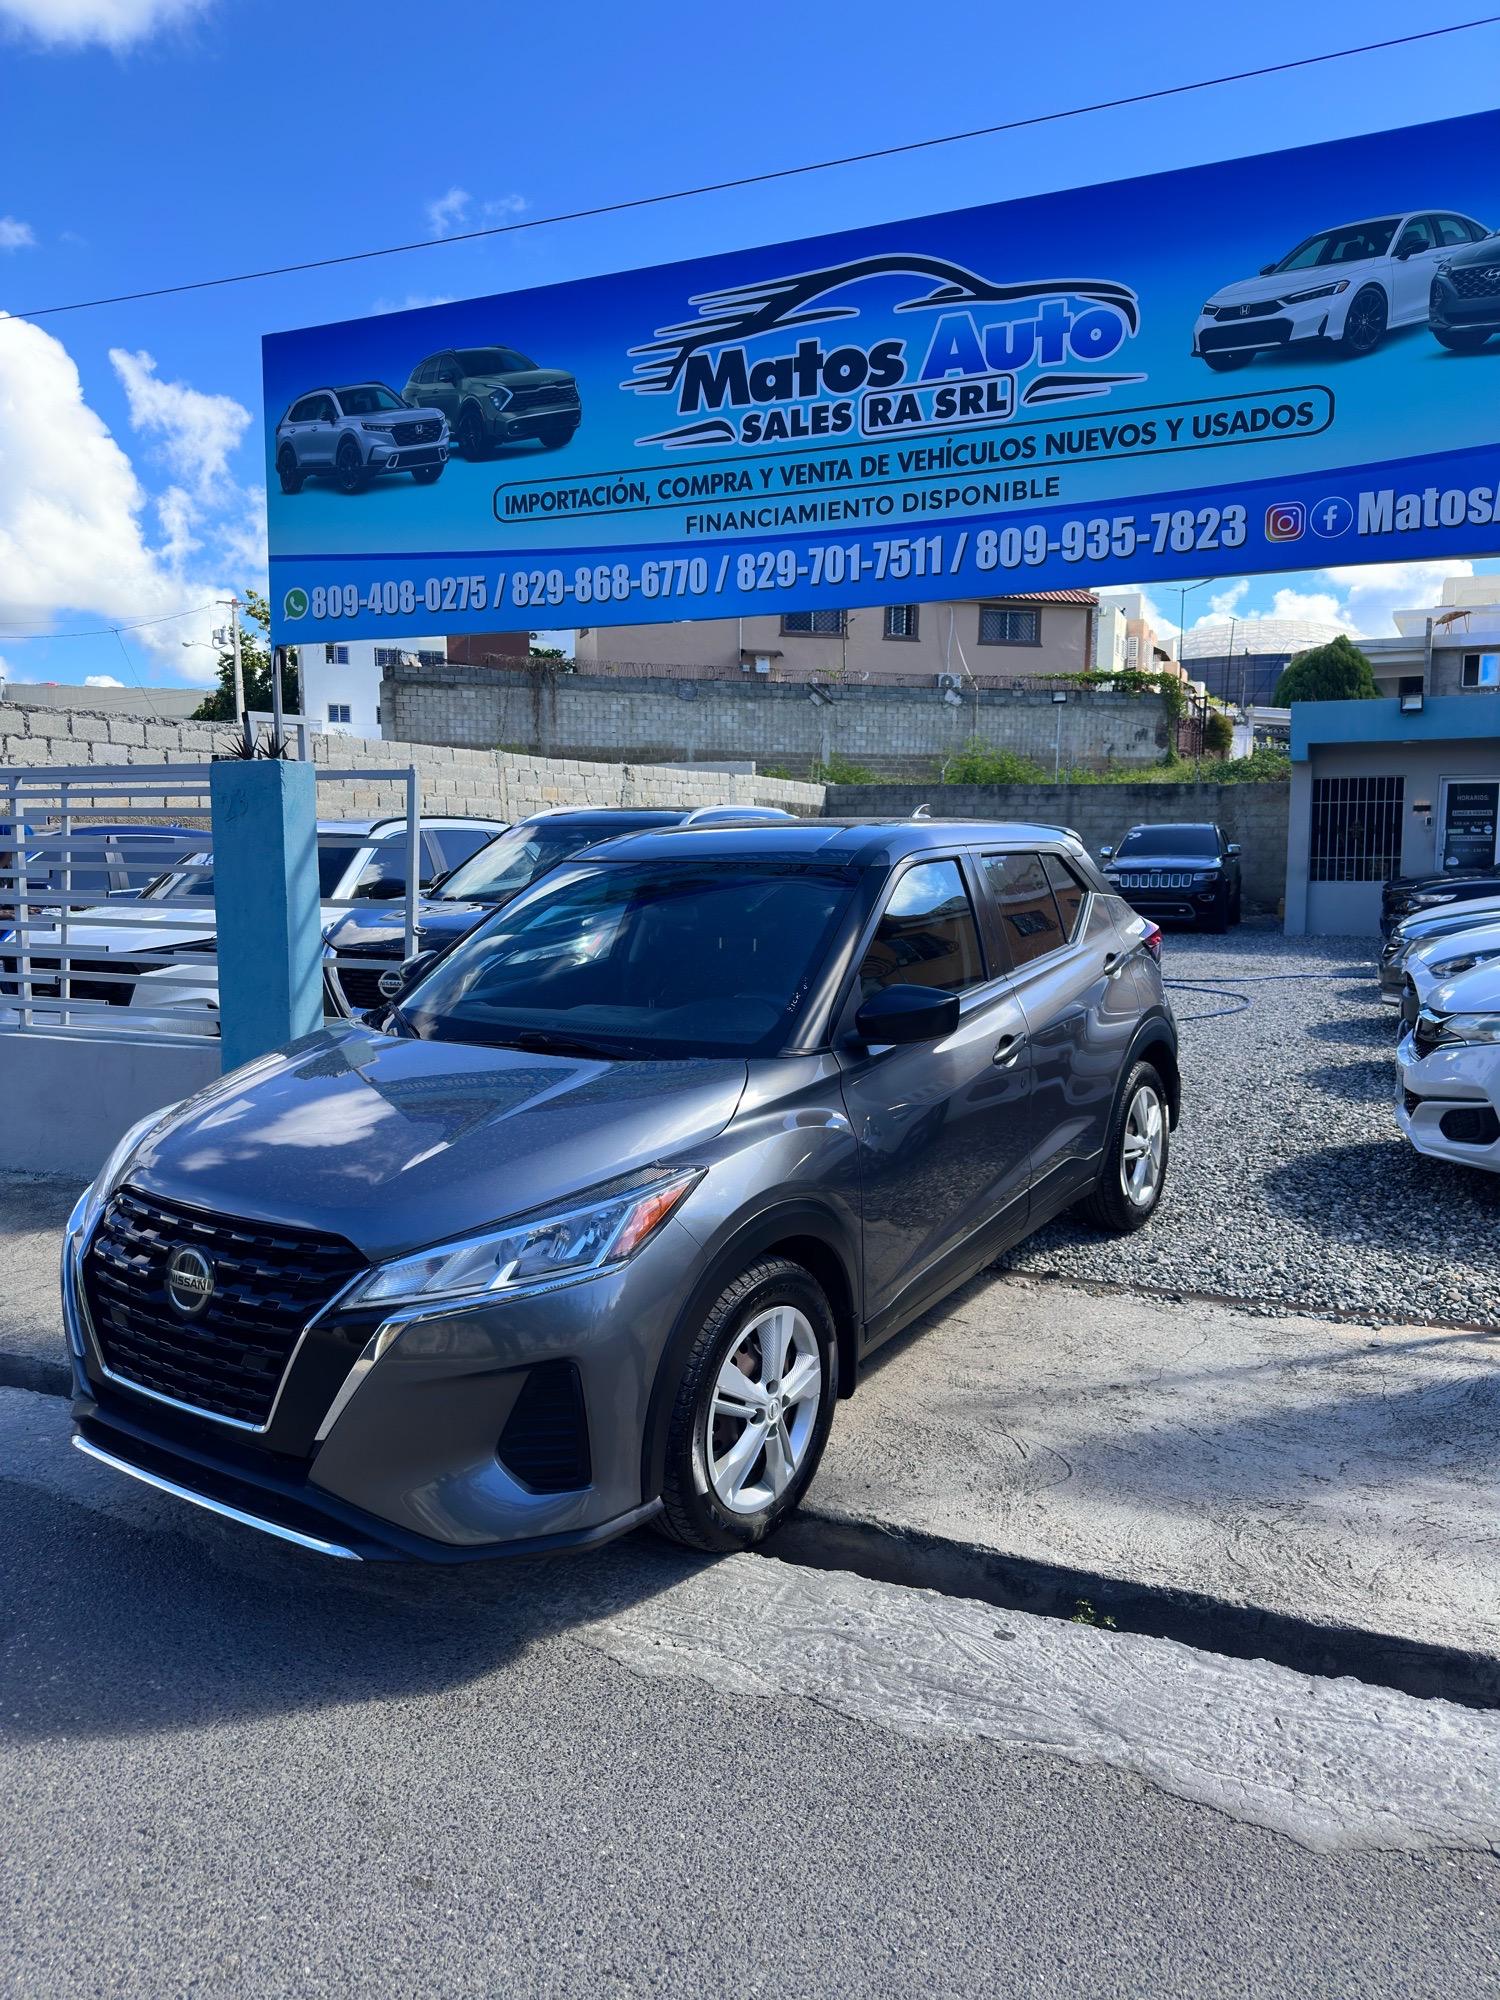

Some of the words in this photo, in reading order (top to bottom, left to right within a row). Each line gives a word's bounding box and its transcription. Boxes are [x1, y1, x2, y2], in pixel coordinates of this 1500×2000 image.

[678, 340, 905, 413] Matos
[921, 300, 1123, 380] Auto
[741, 402, 852, 444] SALES
[868, 393, 924, 428] RA
[934, 382, 1007, 419] SRL
[504, 477, 651, 515] IMPORTACIÓN,
[657, 471, 753, 500] COMPRA
[759, 468, 774, 488] Y
[780, 459, 853, 487] VENTA
[861, 454, 890, 478] DE
[898, 435, 1037, 473] VEHÍCULOS
[1045, 421, 1157, 456] NUEVOS
[1166, 418, 1184, 442] Y
[1193, 401, 1314, 439] USADOS
[686, 495, 894, 534] FINANCIAMIENTO
[903, 476, 1060, 513] DISPONIBLE
[312, 575, 487, 620] 809-408-0275
[512, 557, 708, 607] 829-868-6770
[737, 536, 943, 592] 829-701-7511
[976, 504, 1247, 571] 809-935-7823
[170, 1272, 207, 1290] NISSAN
